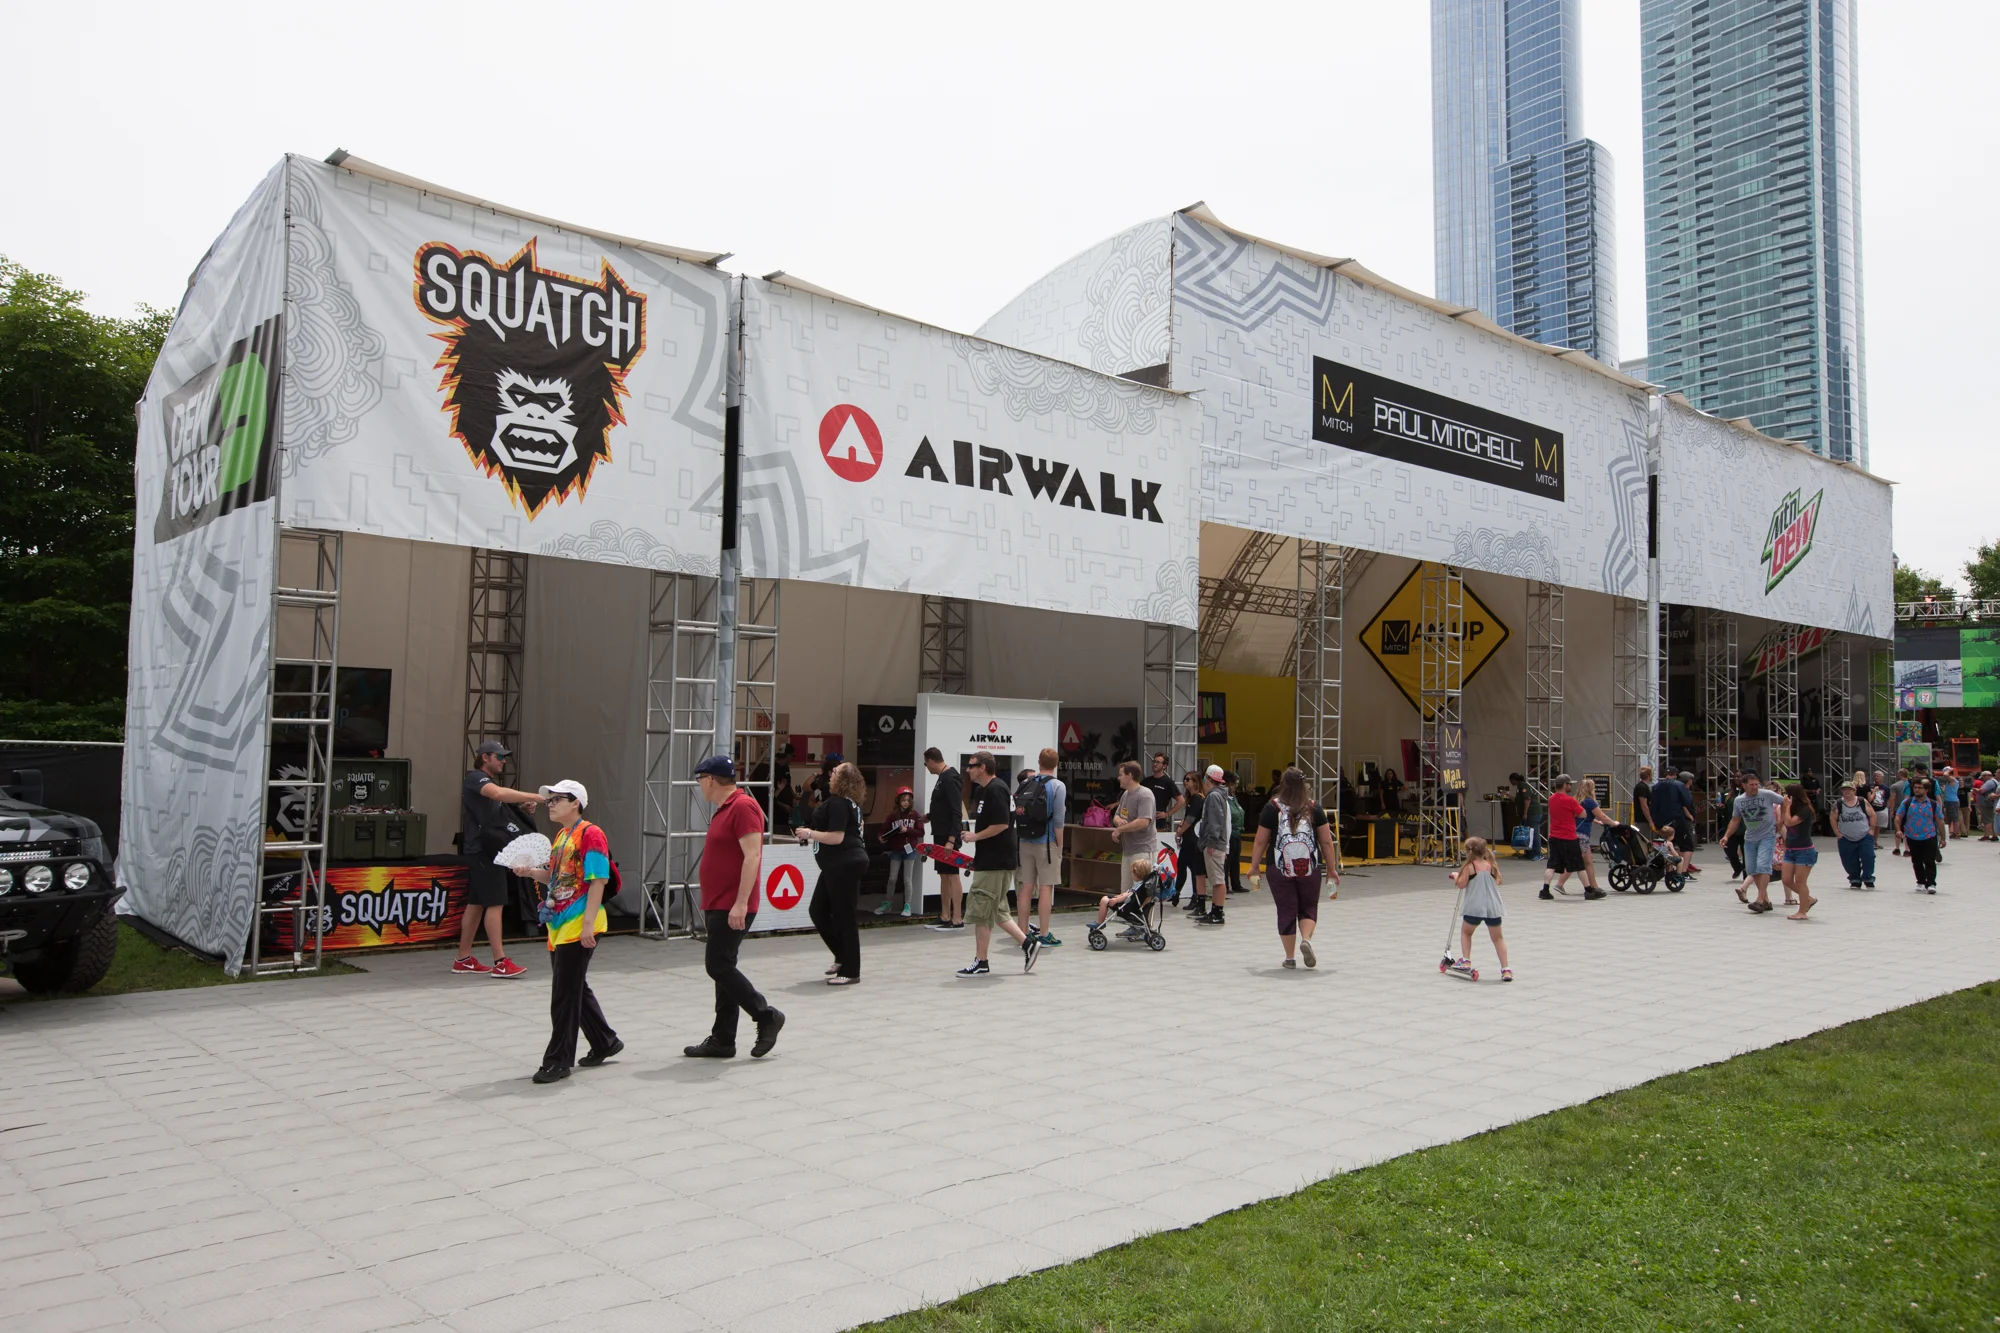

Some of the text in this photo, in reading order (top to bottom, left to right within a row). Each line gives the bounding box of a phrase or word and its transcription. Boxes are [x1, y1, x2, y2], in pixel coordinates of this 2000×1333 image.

[427, 254, 636, 359] SQUATCH
[1322, 374, 1353, 418] M
[171, 375, 220, 463] DEW
[1322, 415, 1353, 434] MITCH
[1374, 403, 1521, 466] PAUL MITCHELL
[1535, 438, 1558, 474] M
[171, 444, 220, 520] TOUR
[904, 435, 1164, 524] AIRWALK
[1535, 472, 1558, 488] MITCH
[1452, 621, 1484, 641] UP
[1384, 644, 1407, 652] MITCH
[969, 734, 1012, 743] AIRWALK
[1445, 728, 1461, 749] M
[1065, 762, 1081, 770] YOUR
[1083, 762, 1103, 771] MARK
[1443, 768, 1460, 784] Man
[347, 772, 375, 783] SQUATCH
[340, 885, 447, 930] SQUATCH
